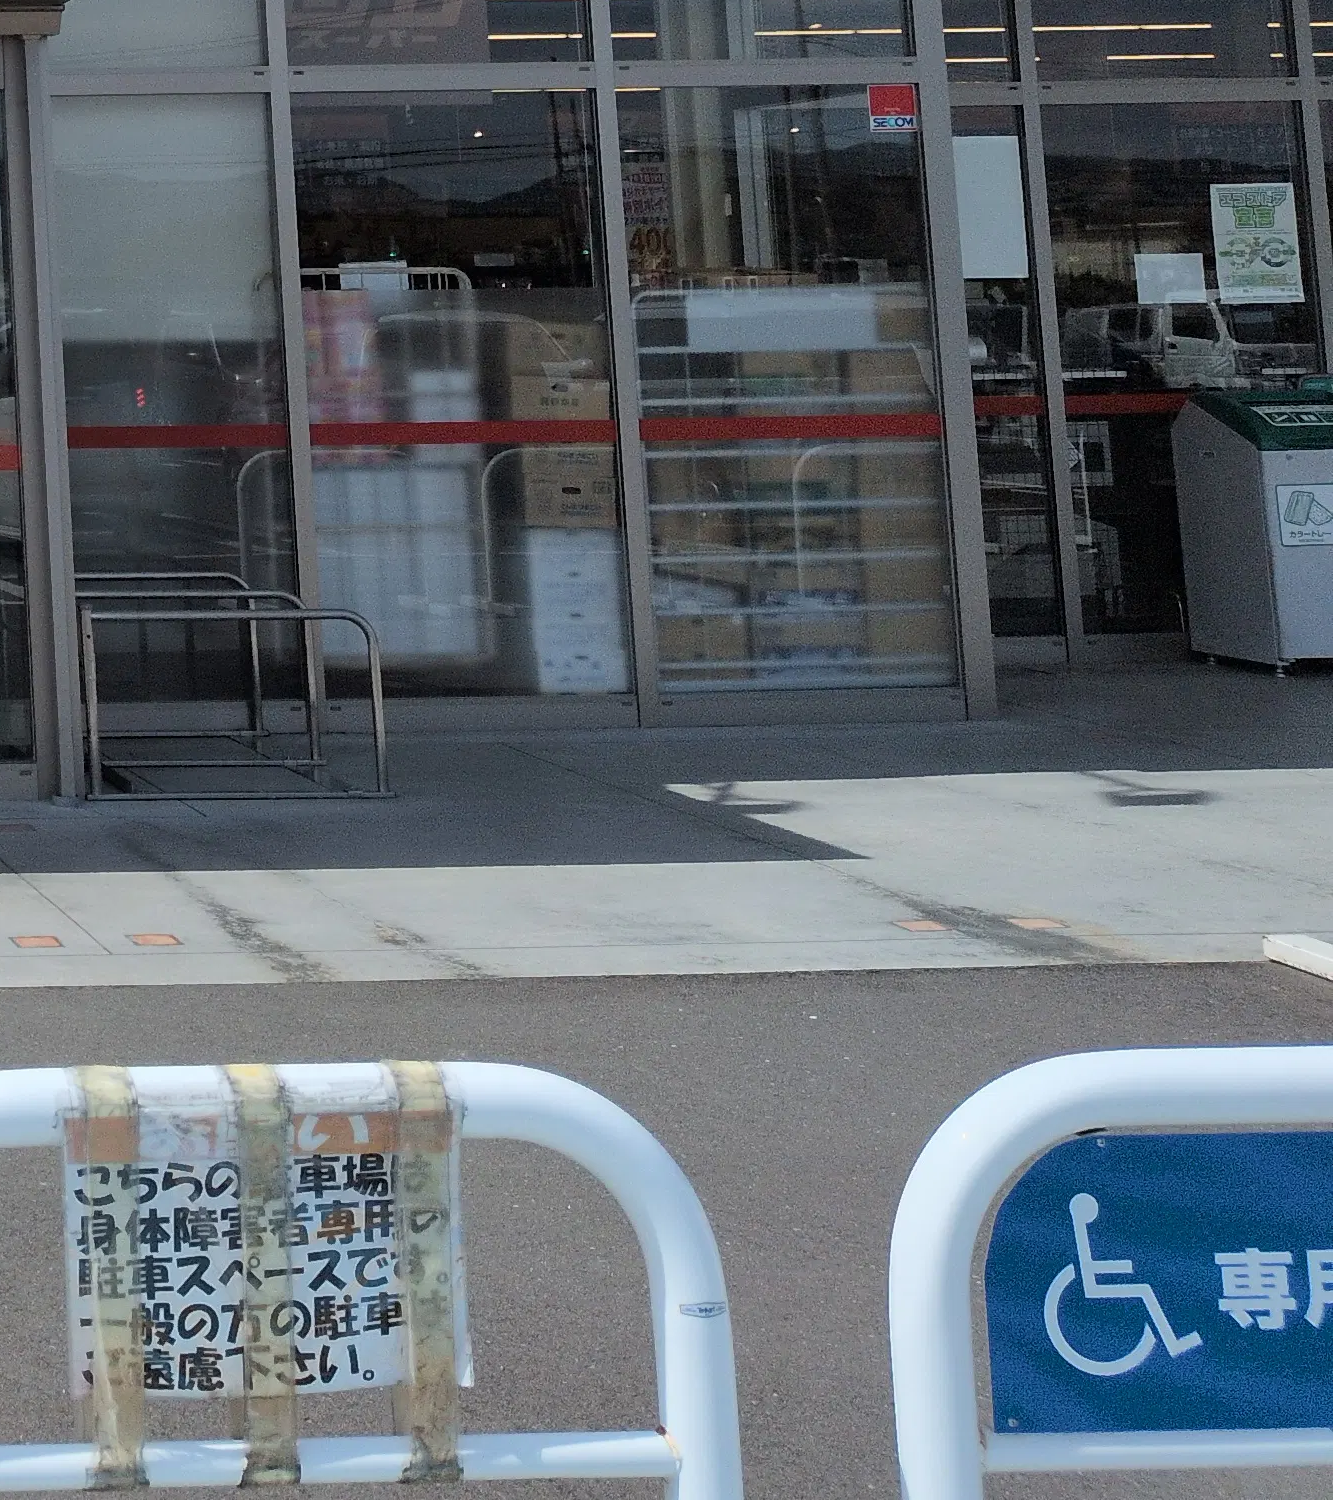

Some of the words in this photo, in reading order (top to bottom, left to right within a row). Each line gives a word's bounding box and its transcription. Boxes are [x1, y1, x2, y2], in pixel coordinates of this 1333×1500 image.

[873, 116, 914, 127] SECOM
[74, 1152, 433, 1205] こちらの車場は
